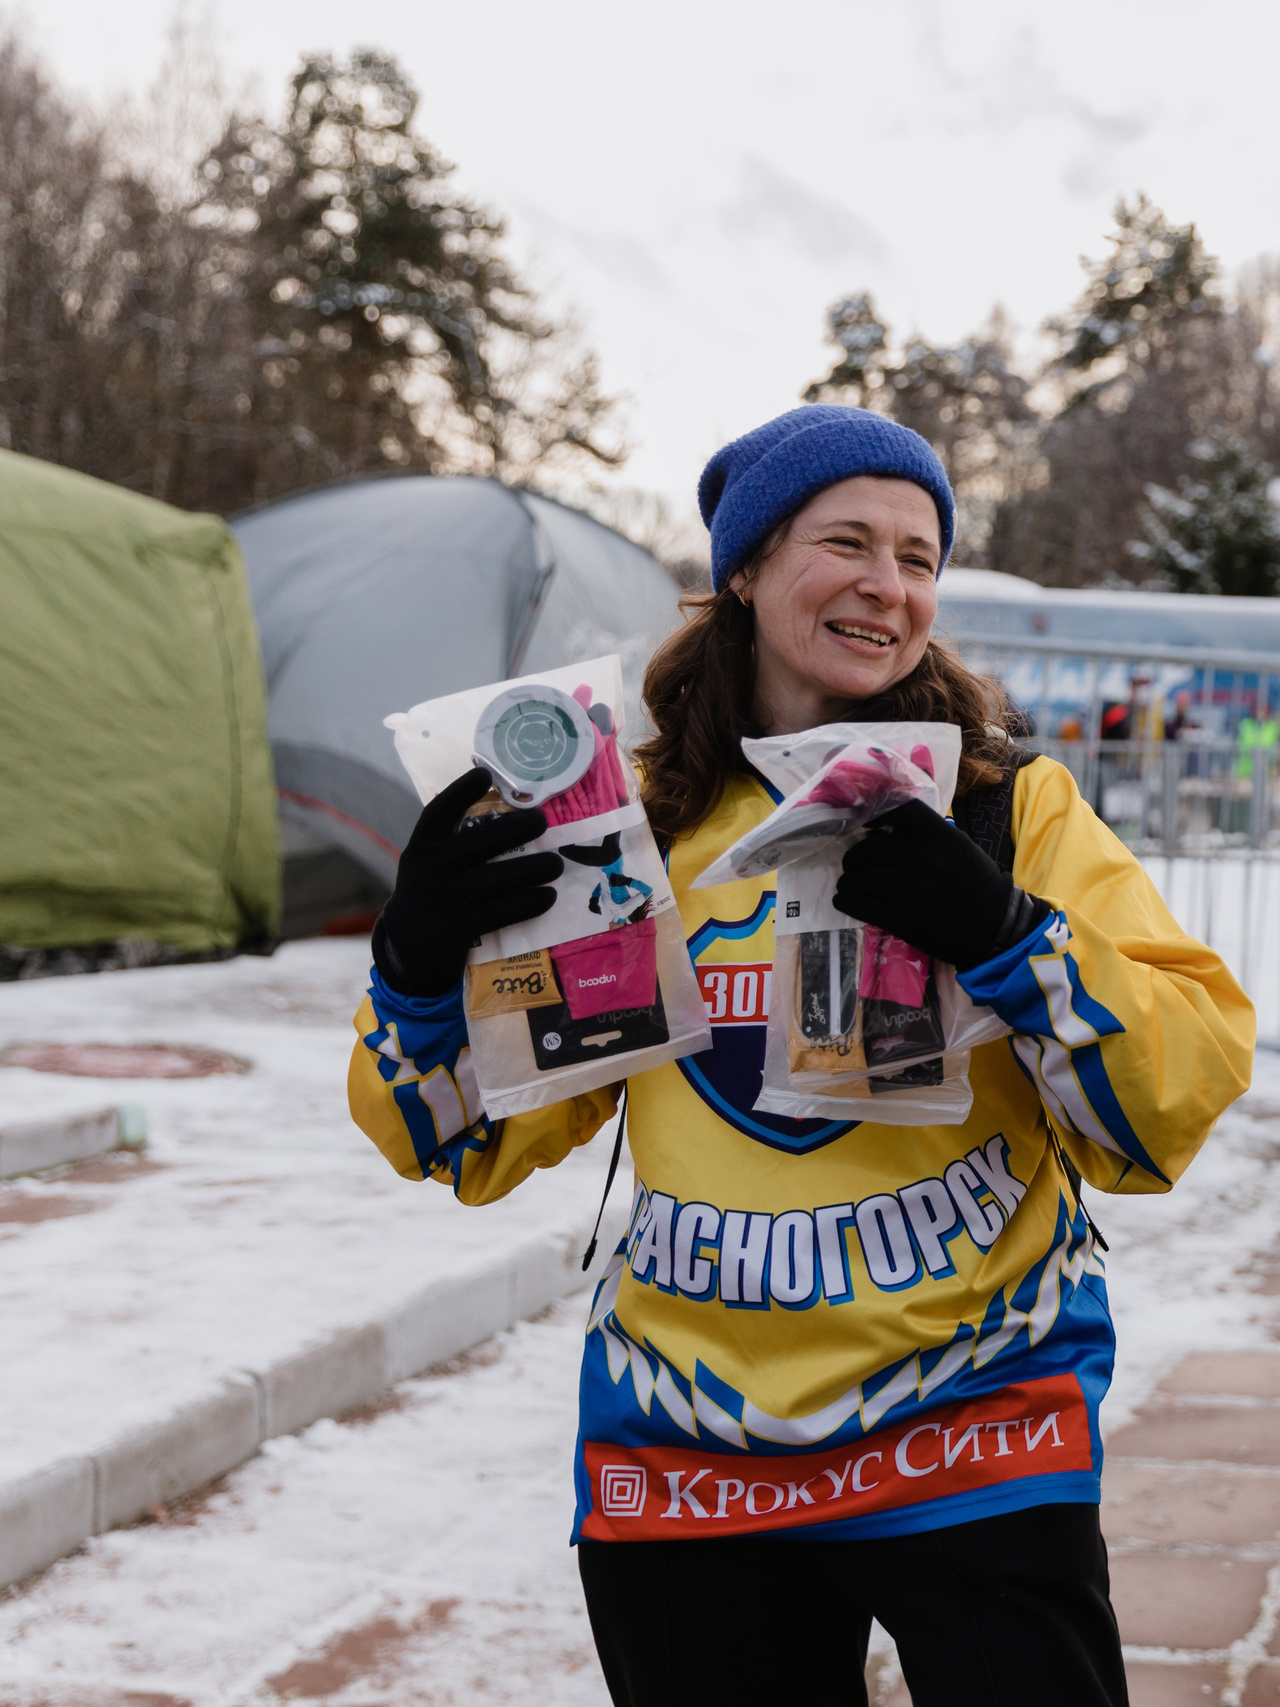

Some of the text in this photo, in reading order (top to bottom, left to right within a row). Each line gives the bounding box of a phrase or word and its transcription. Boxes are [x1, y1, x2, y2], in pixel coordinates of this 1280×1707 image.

[492, 971, 545, 995] Bite
[544, 1033, 561, 1049] S/M
[625, 1133, 1030, 1311] РАСНОГОРСК
